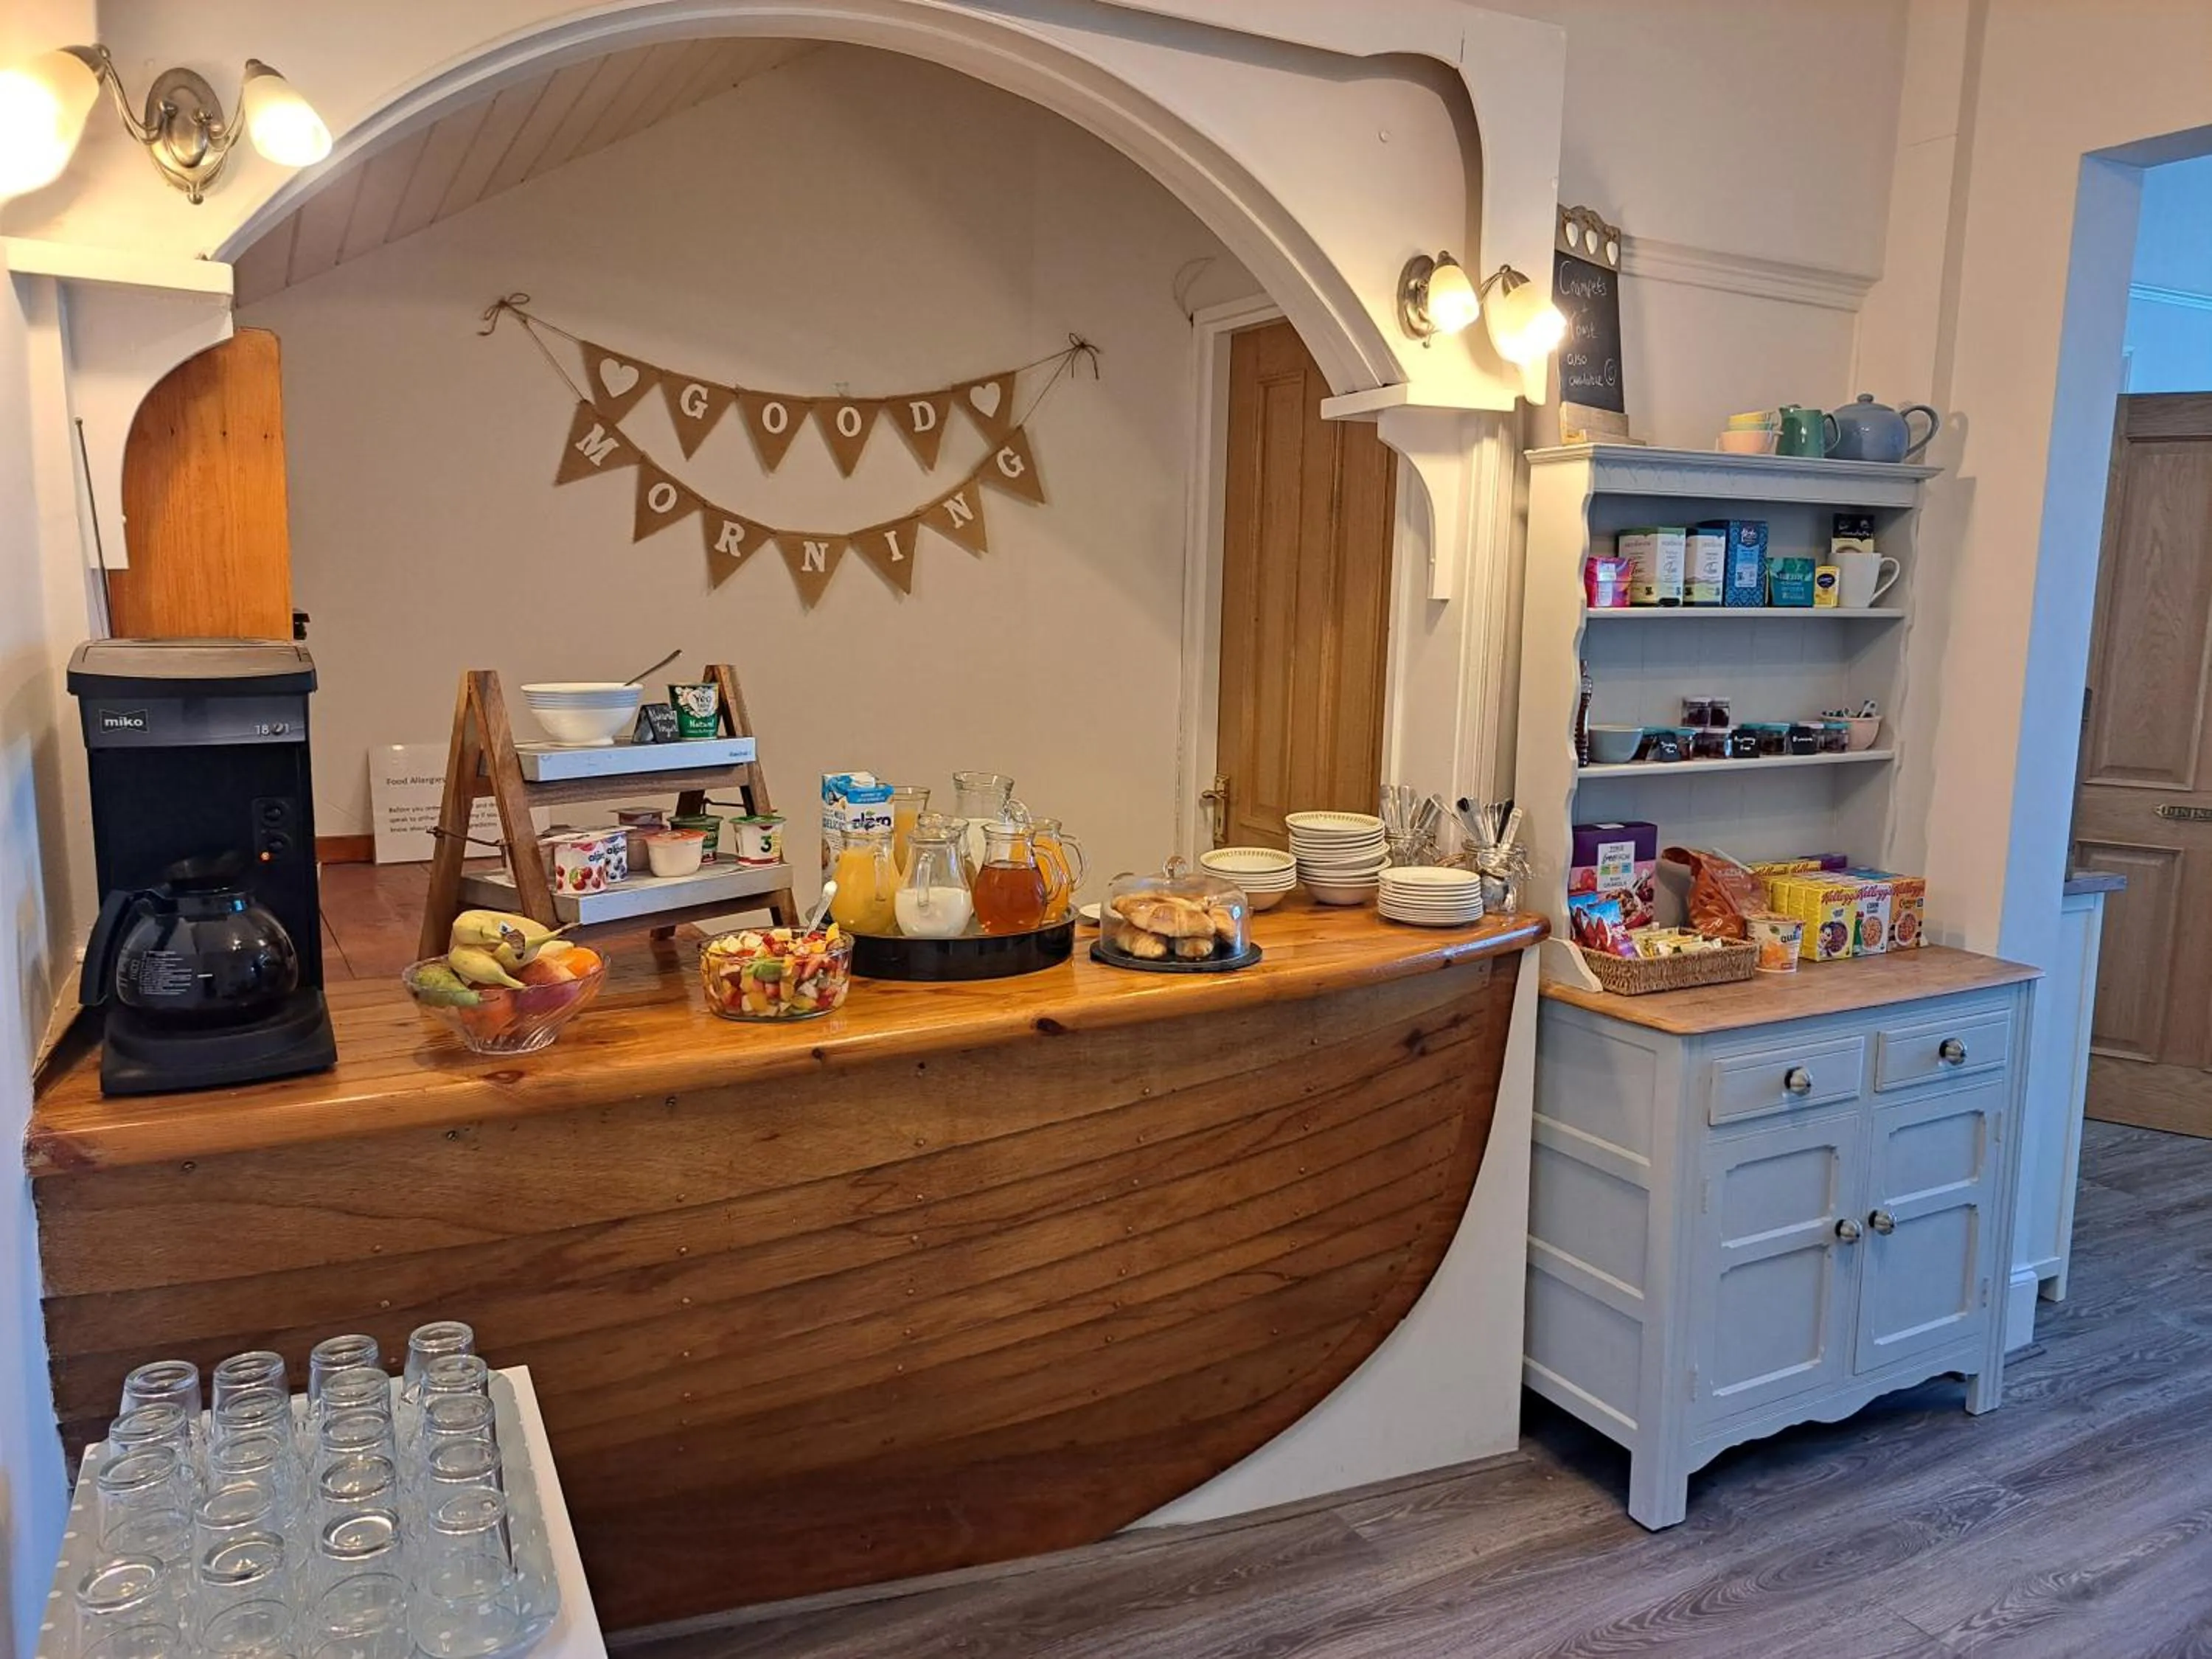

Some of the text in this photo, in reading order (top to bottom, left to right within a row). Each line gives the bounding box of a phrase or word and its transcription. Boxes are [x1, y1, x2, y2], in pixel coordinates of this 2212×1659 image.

[680, 383, 936, 437] GOOD
[574, 422, 1026, 573] MORNING
[104, 717, 144, 727] miko
[386, 777, 408, 785] Food
